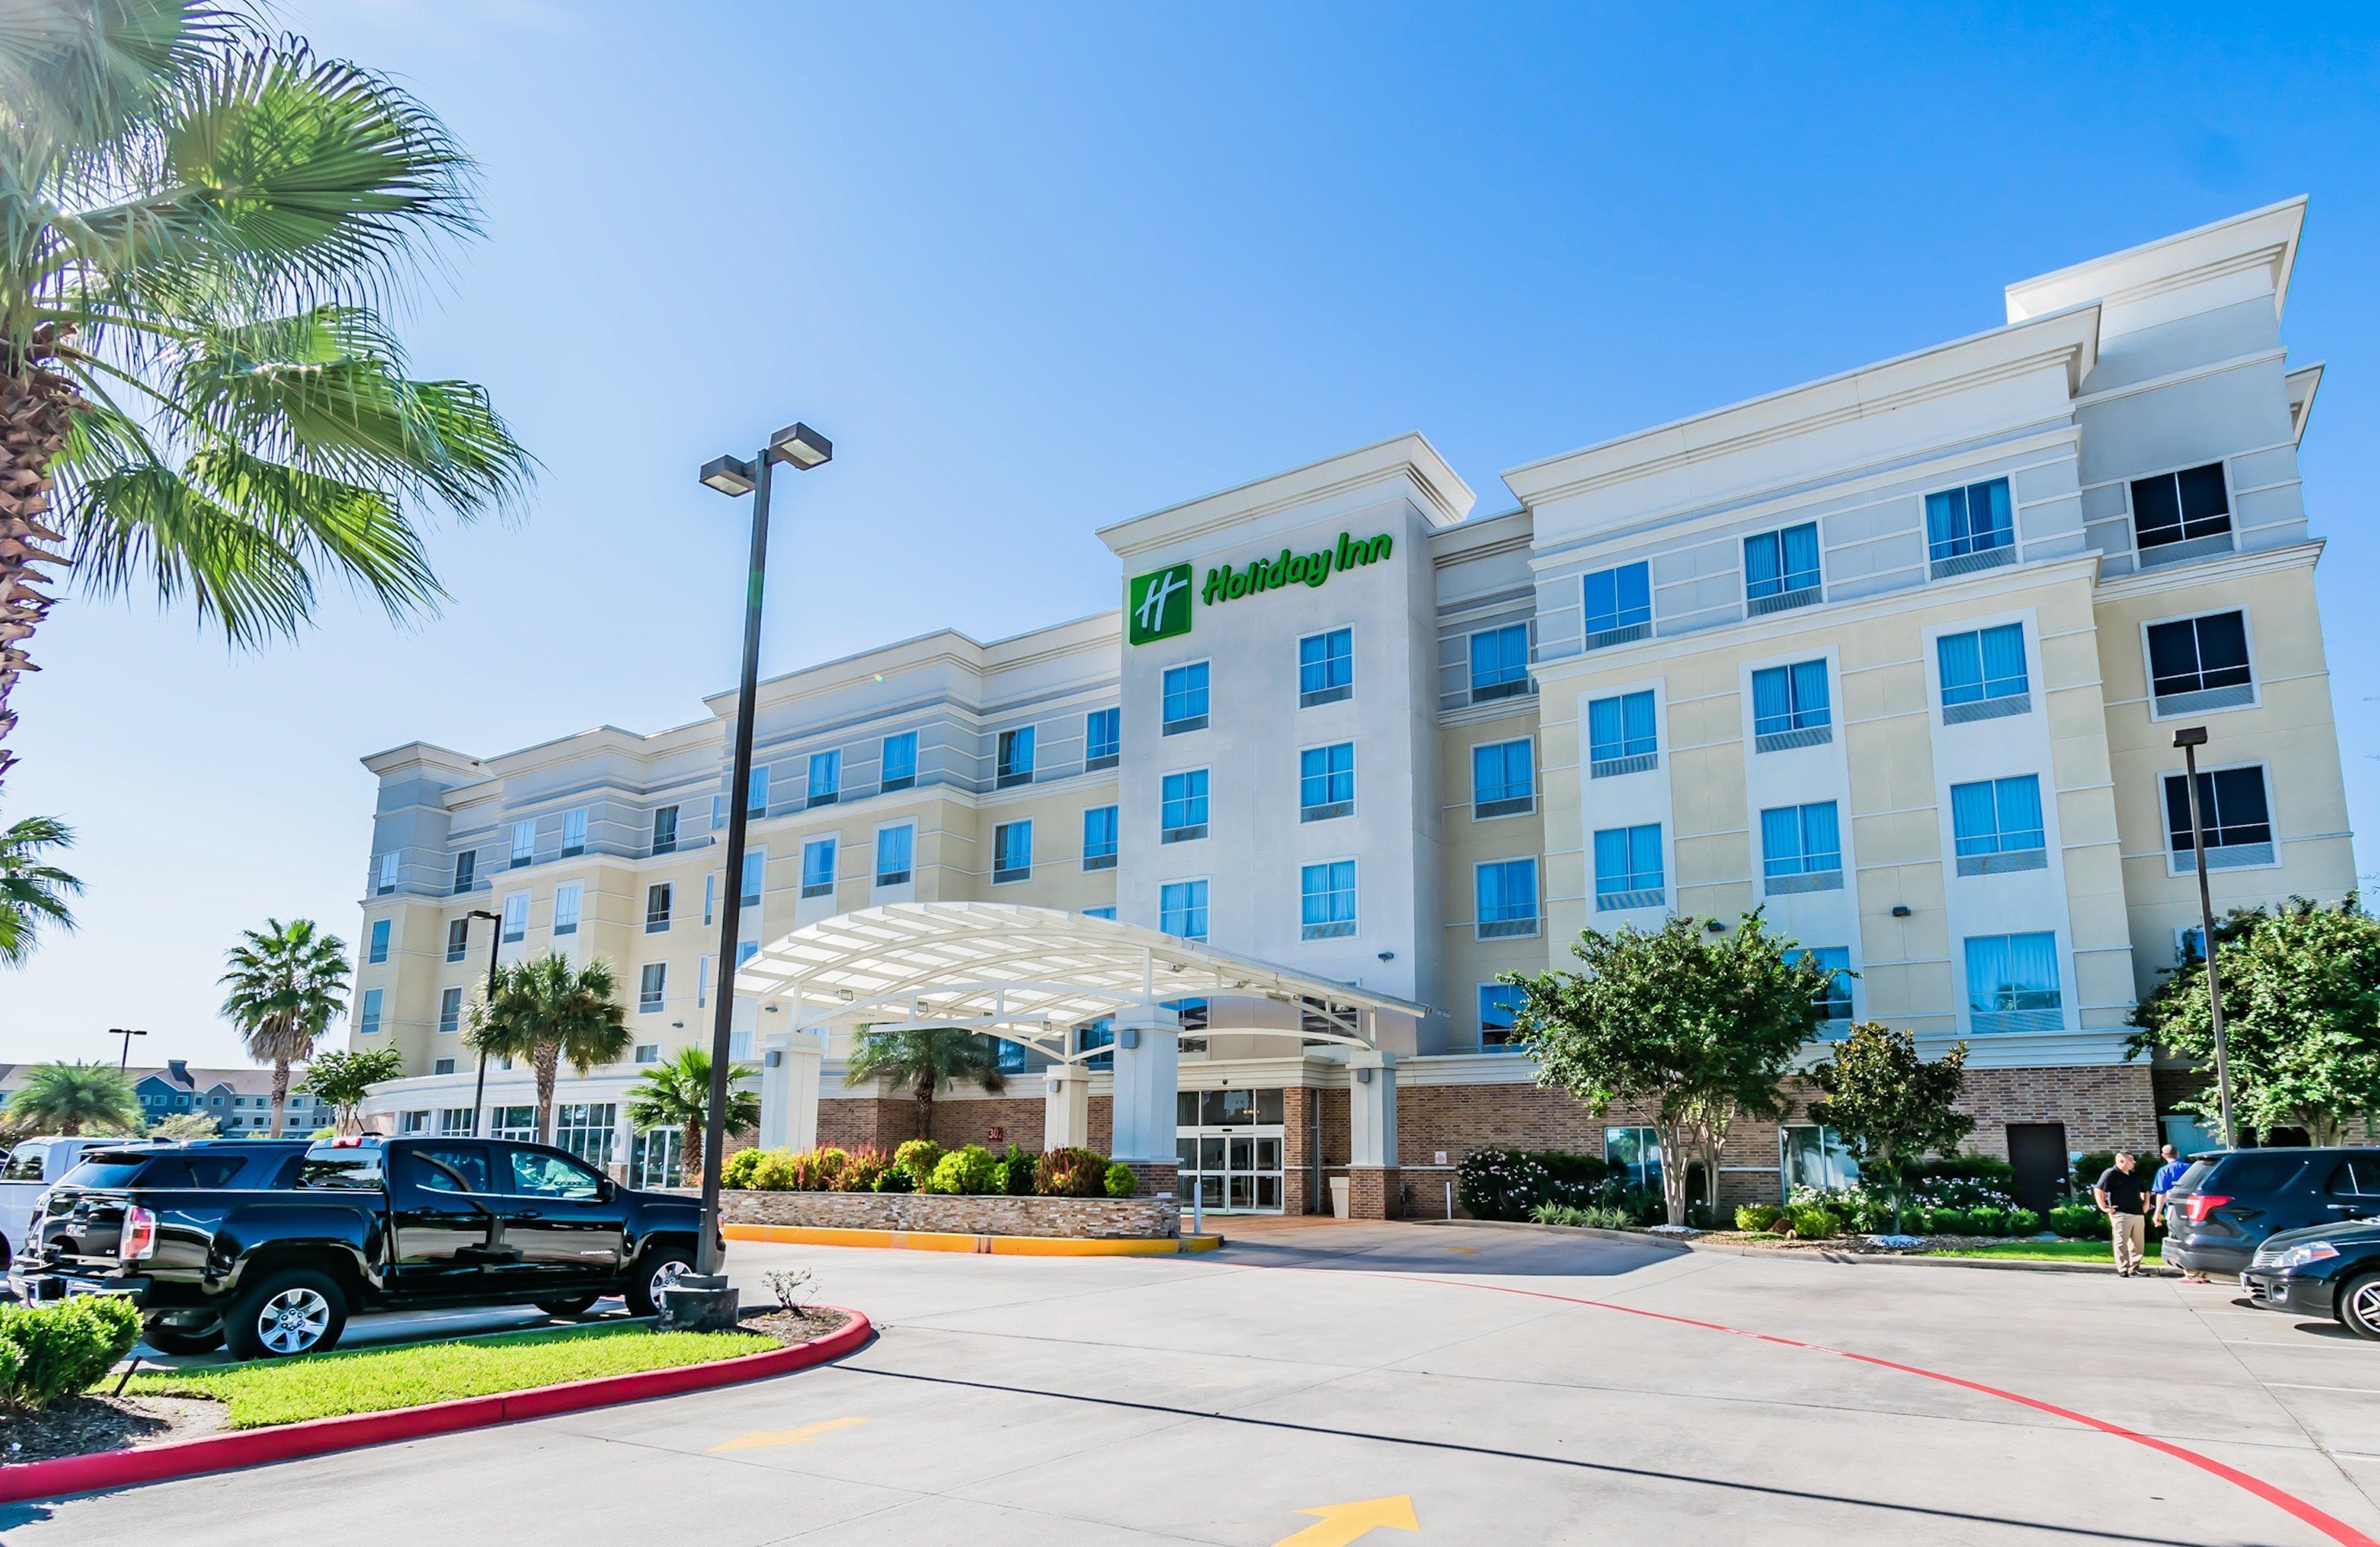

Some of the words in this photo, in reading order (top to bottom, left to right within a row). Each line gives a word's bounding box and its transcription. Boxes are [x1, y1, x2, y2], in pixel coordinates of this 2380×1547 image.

[1135, 571, 1188, 632] H
[1201, 549, 1333, 606] Holiday
[1335, 532, 1392, 572] Inn
